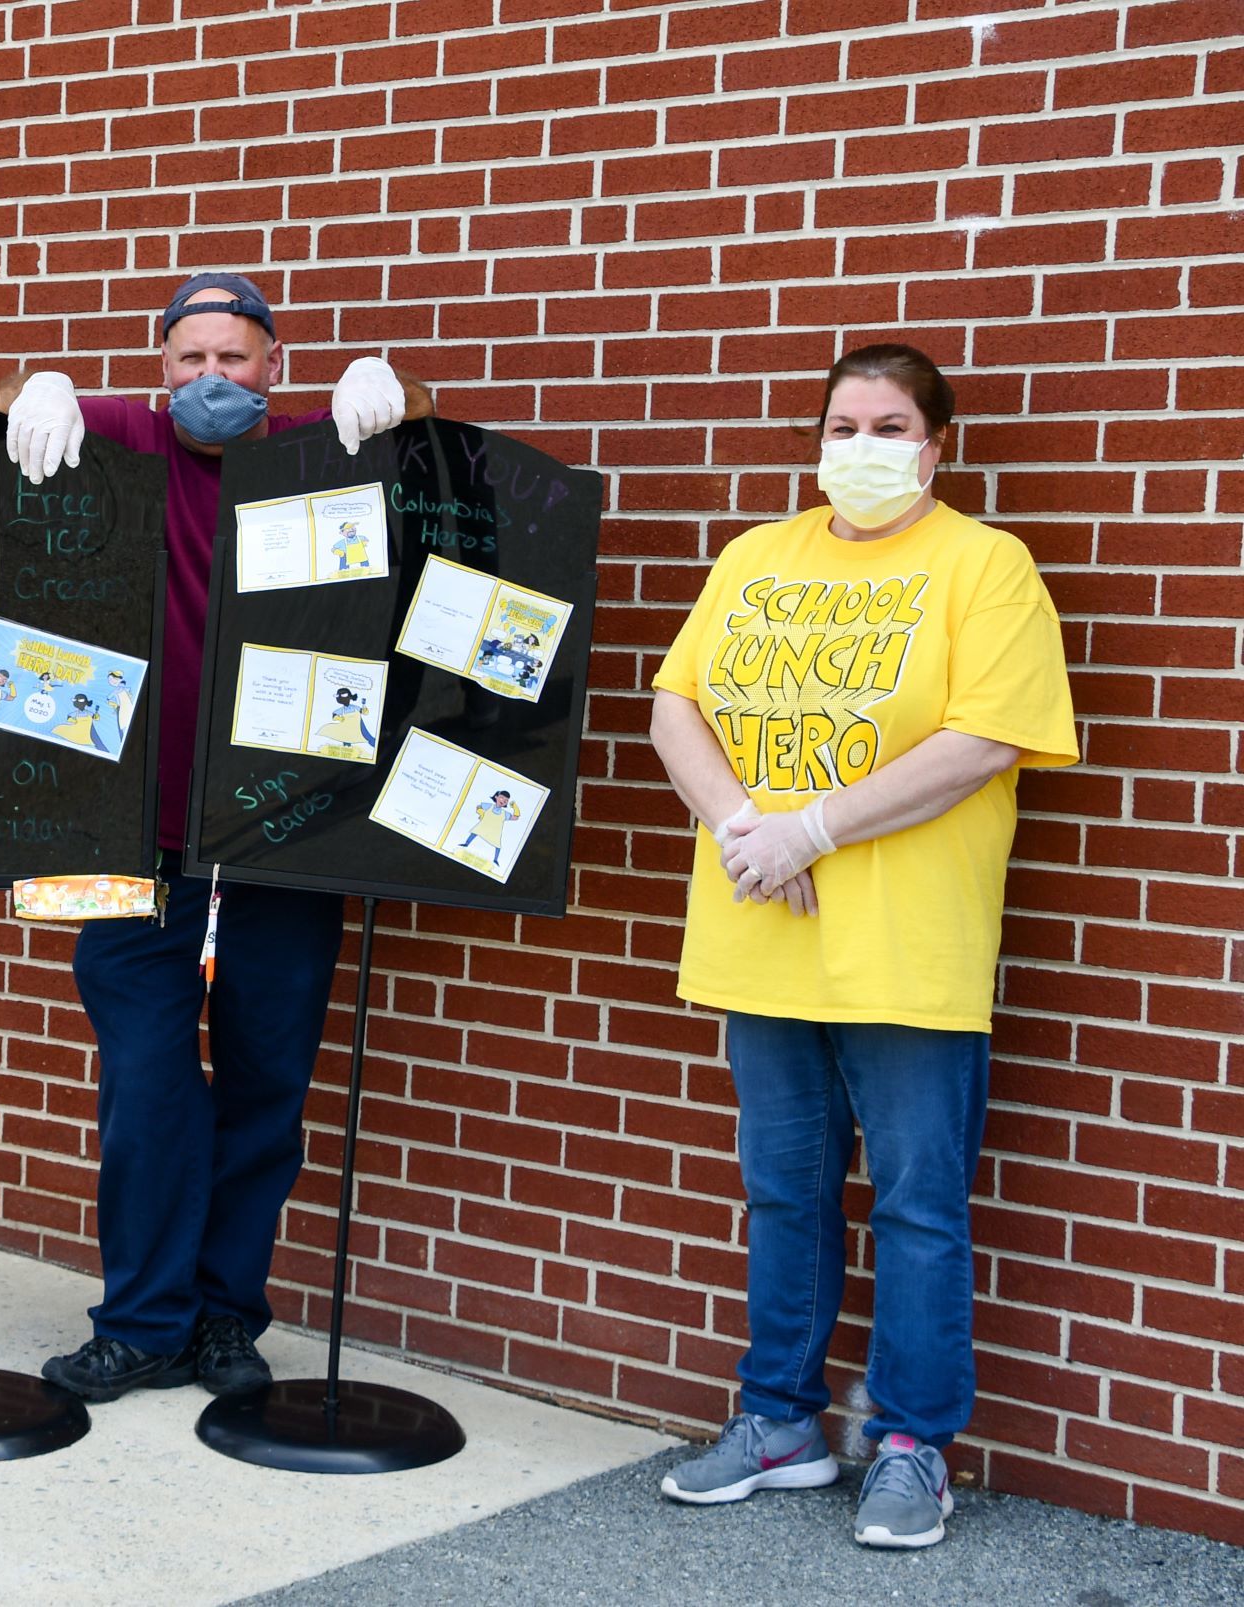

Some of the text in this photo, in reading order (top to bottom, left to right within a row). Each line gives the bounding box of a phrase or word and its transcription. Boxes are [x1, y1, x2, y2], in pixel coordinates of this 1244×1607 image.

[16, 468, 100, 516] Free
[420, 519, 497, 553] Heros
[727, 573, 929, 629] SCHOOL
[16, 652, 87, 684] HERO DAY
[19, 636, 92, 668] SCHOOL LUNCH
[708, 631, 911, 692] LUNCH
[715, 707, 879, 792] HERO
[12, 759, 59, 788] on
[234, 771, 300, 810] Sign
